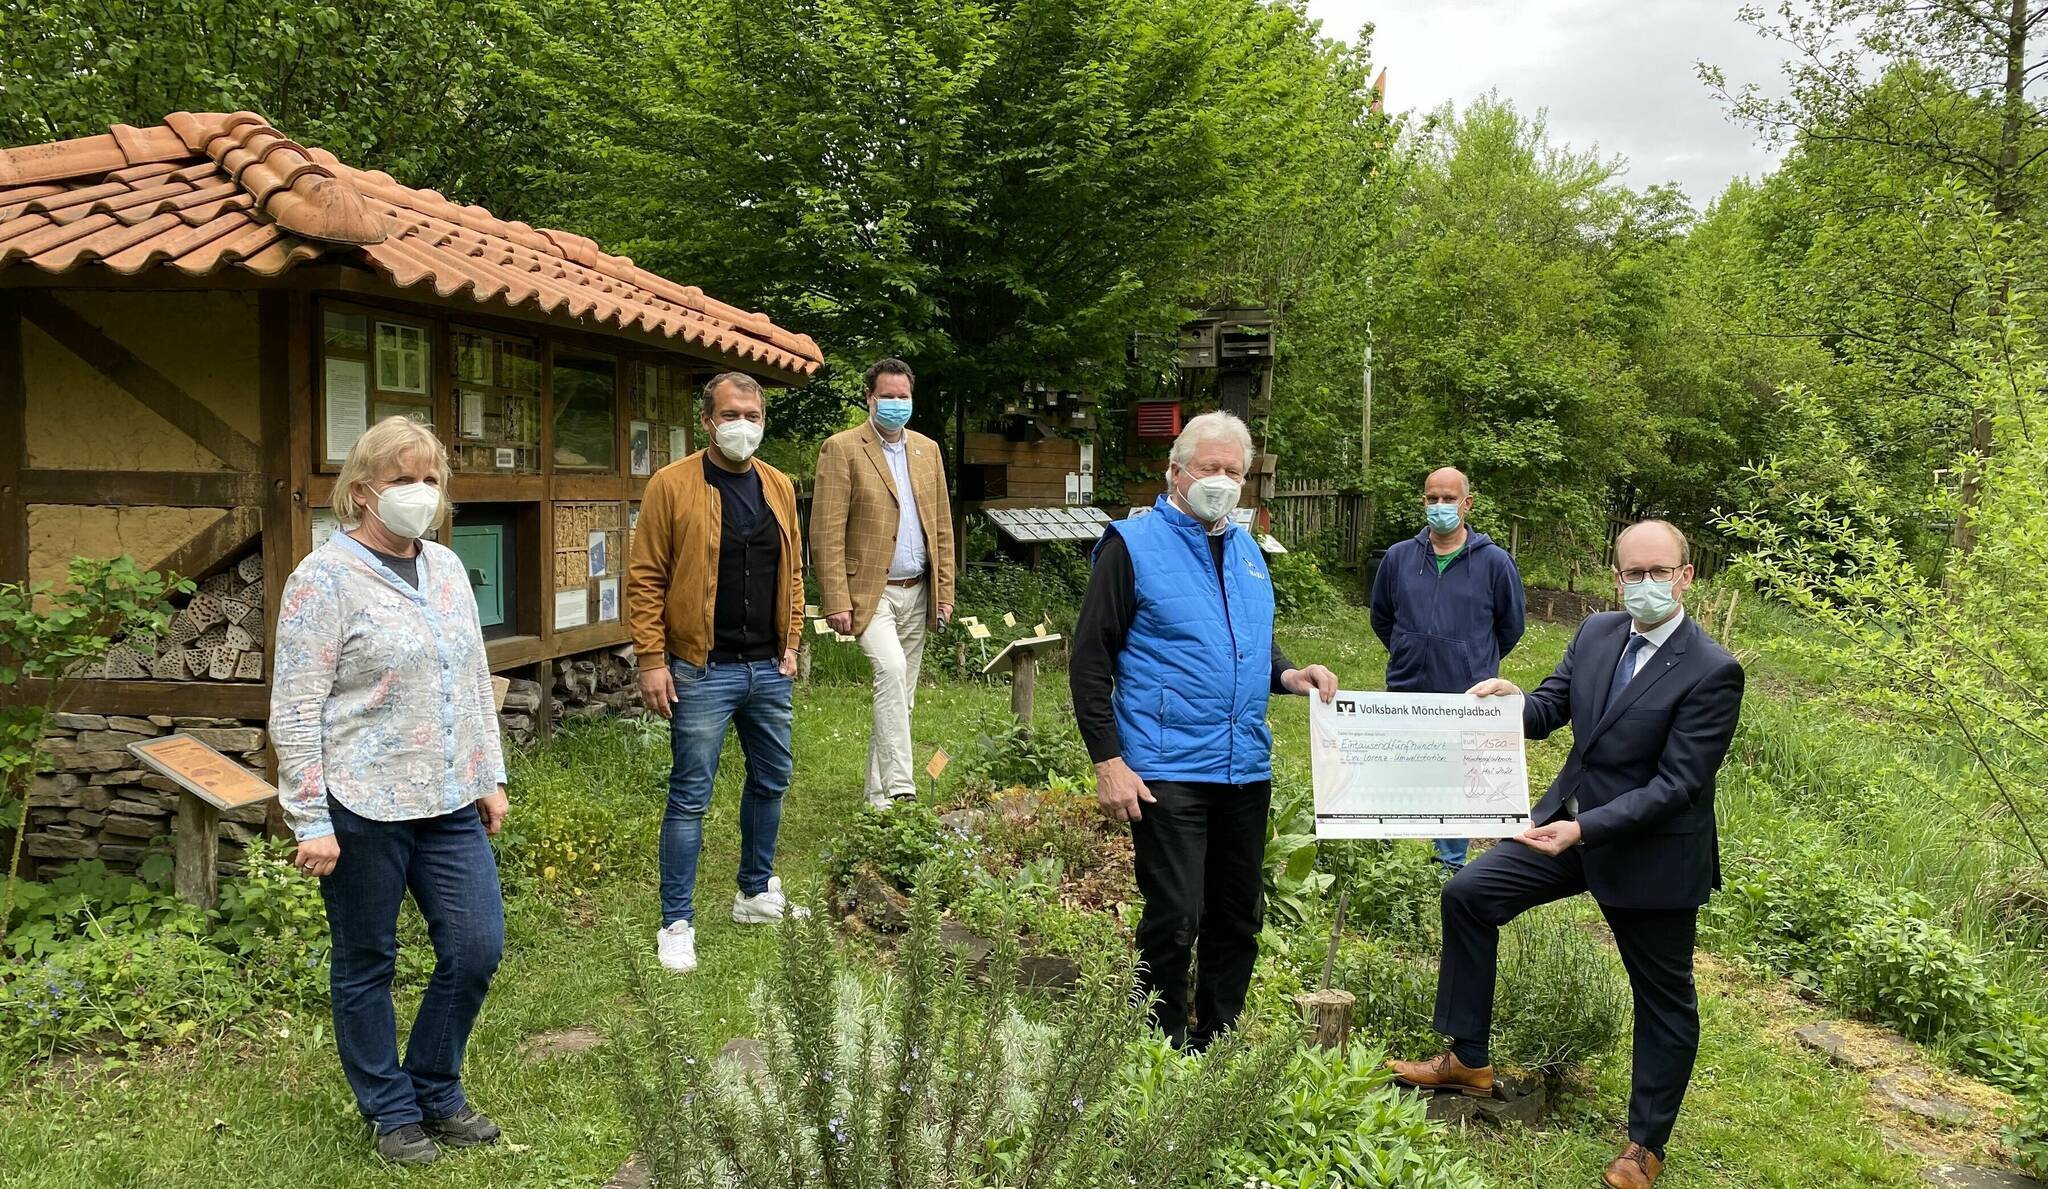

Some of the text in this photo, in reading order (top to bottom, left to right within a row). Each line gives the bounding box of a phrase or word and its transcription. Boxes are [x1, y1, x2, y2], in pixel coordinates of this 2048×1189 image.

[1359, 704, 1502, 719] Volksbank Mönchengladbach
[1340, 738, 1447, 753] Eintausendfünfhundert
